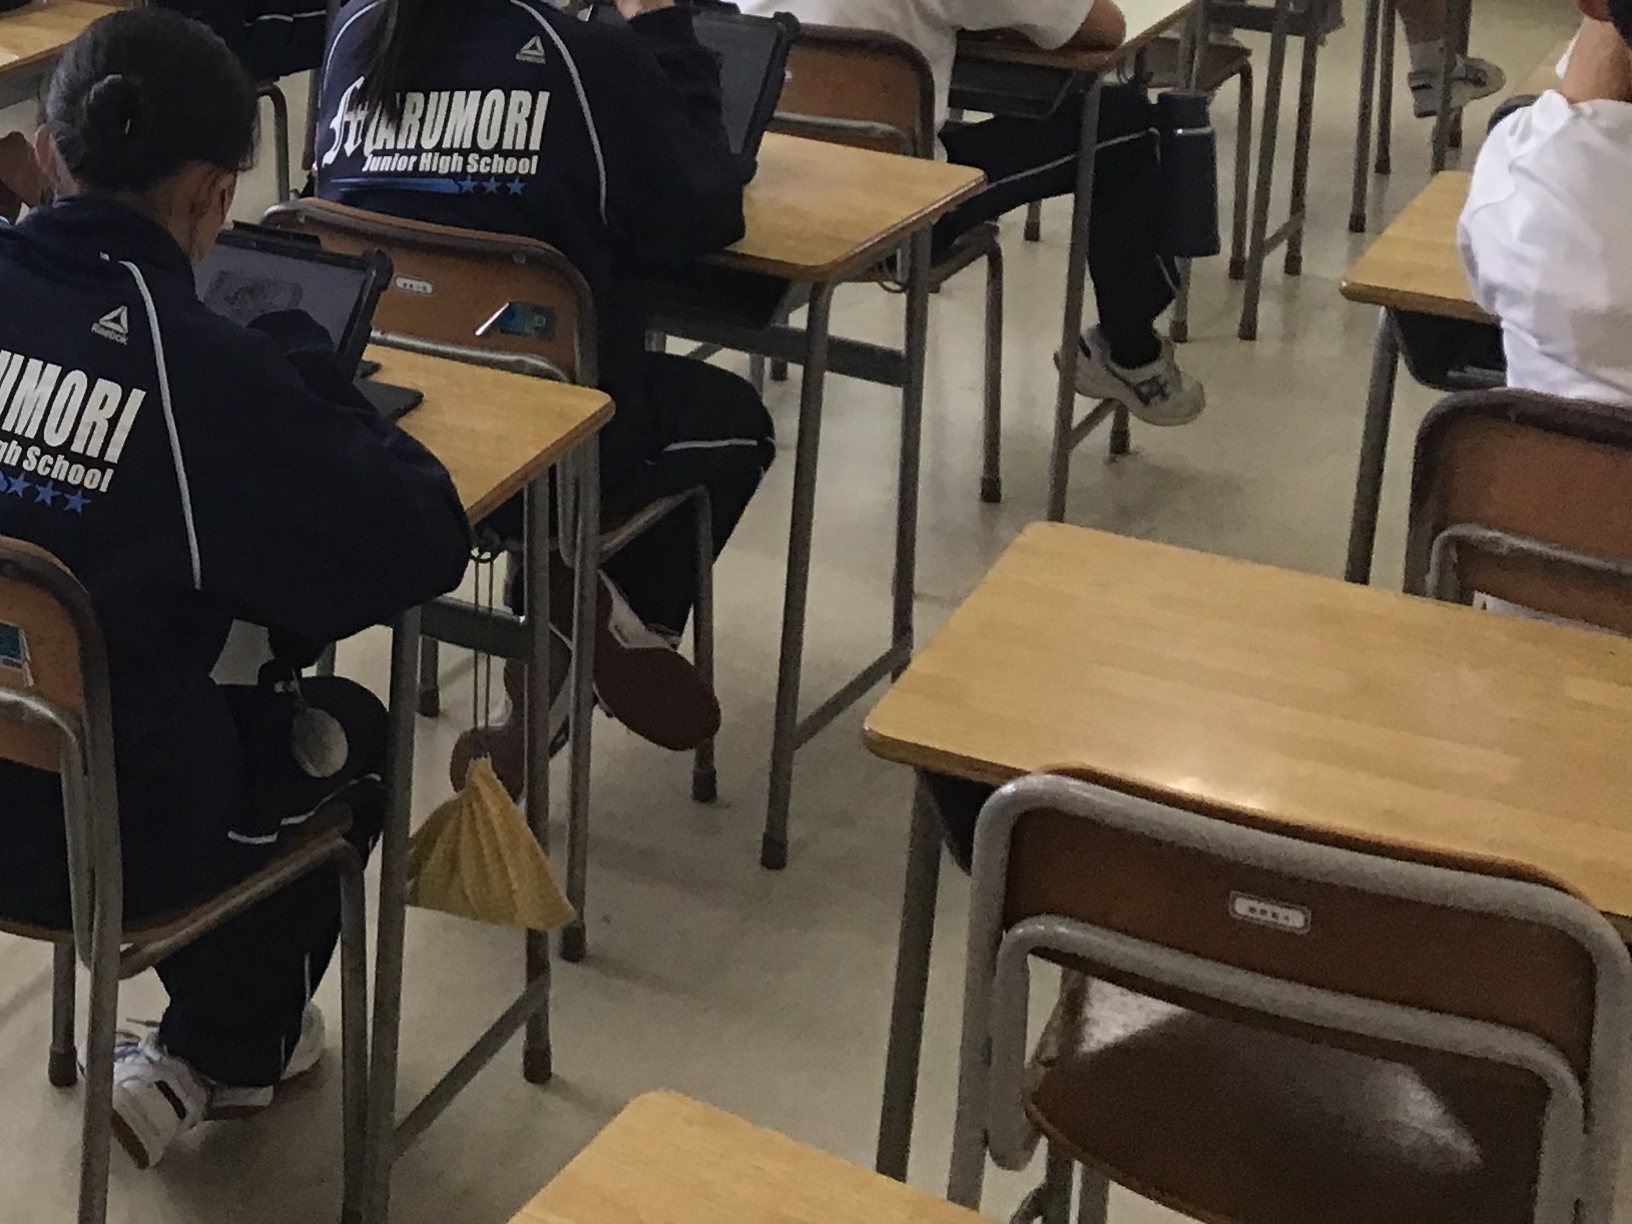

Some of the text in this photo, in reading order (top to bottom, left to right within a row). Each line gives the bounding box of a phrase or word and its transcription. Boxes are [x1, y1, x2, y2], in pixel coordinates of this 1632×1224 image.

[362, 153, 538, 176] Junior High School
[22, 445, 115, 493] School
